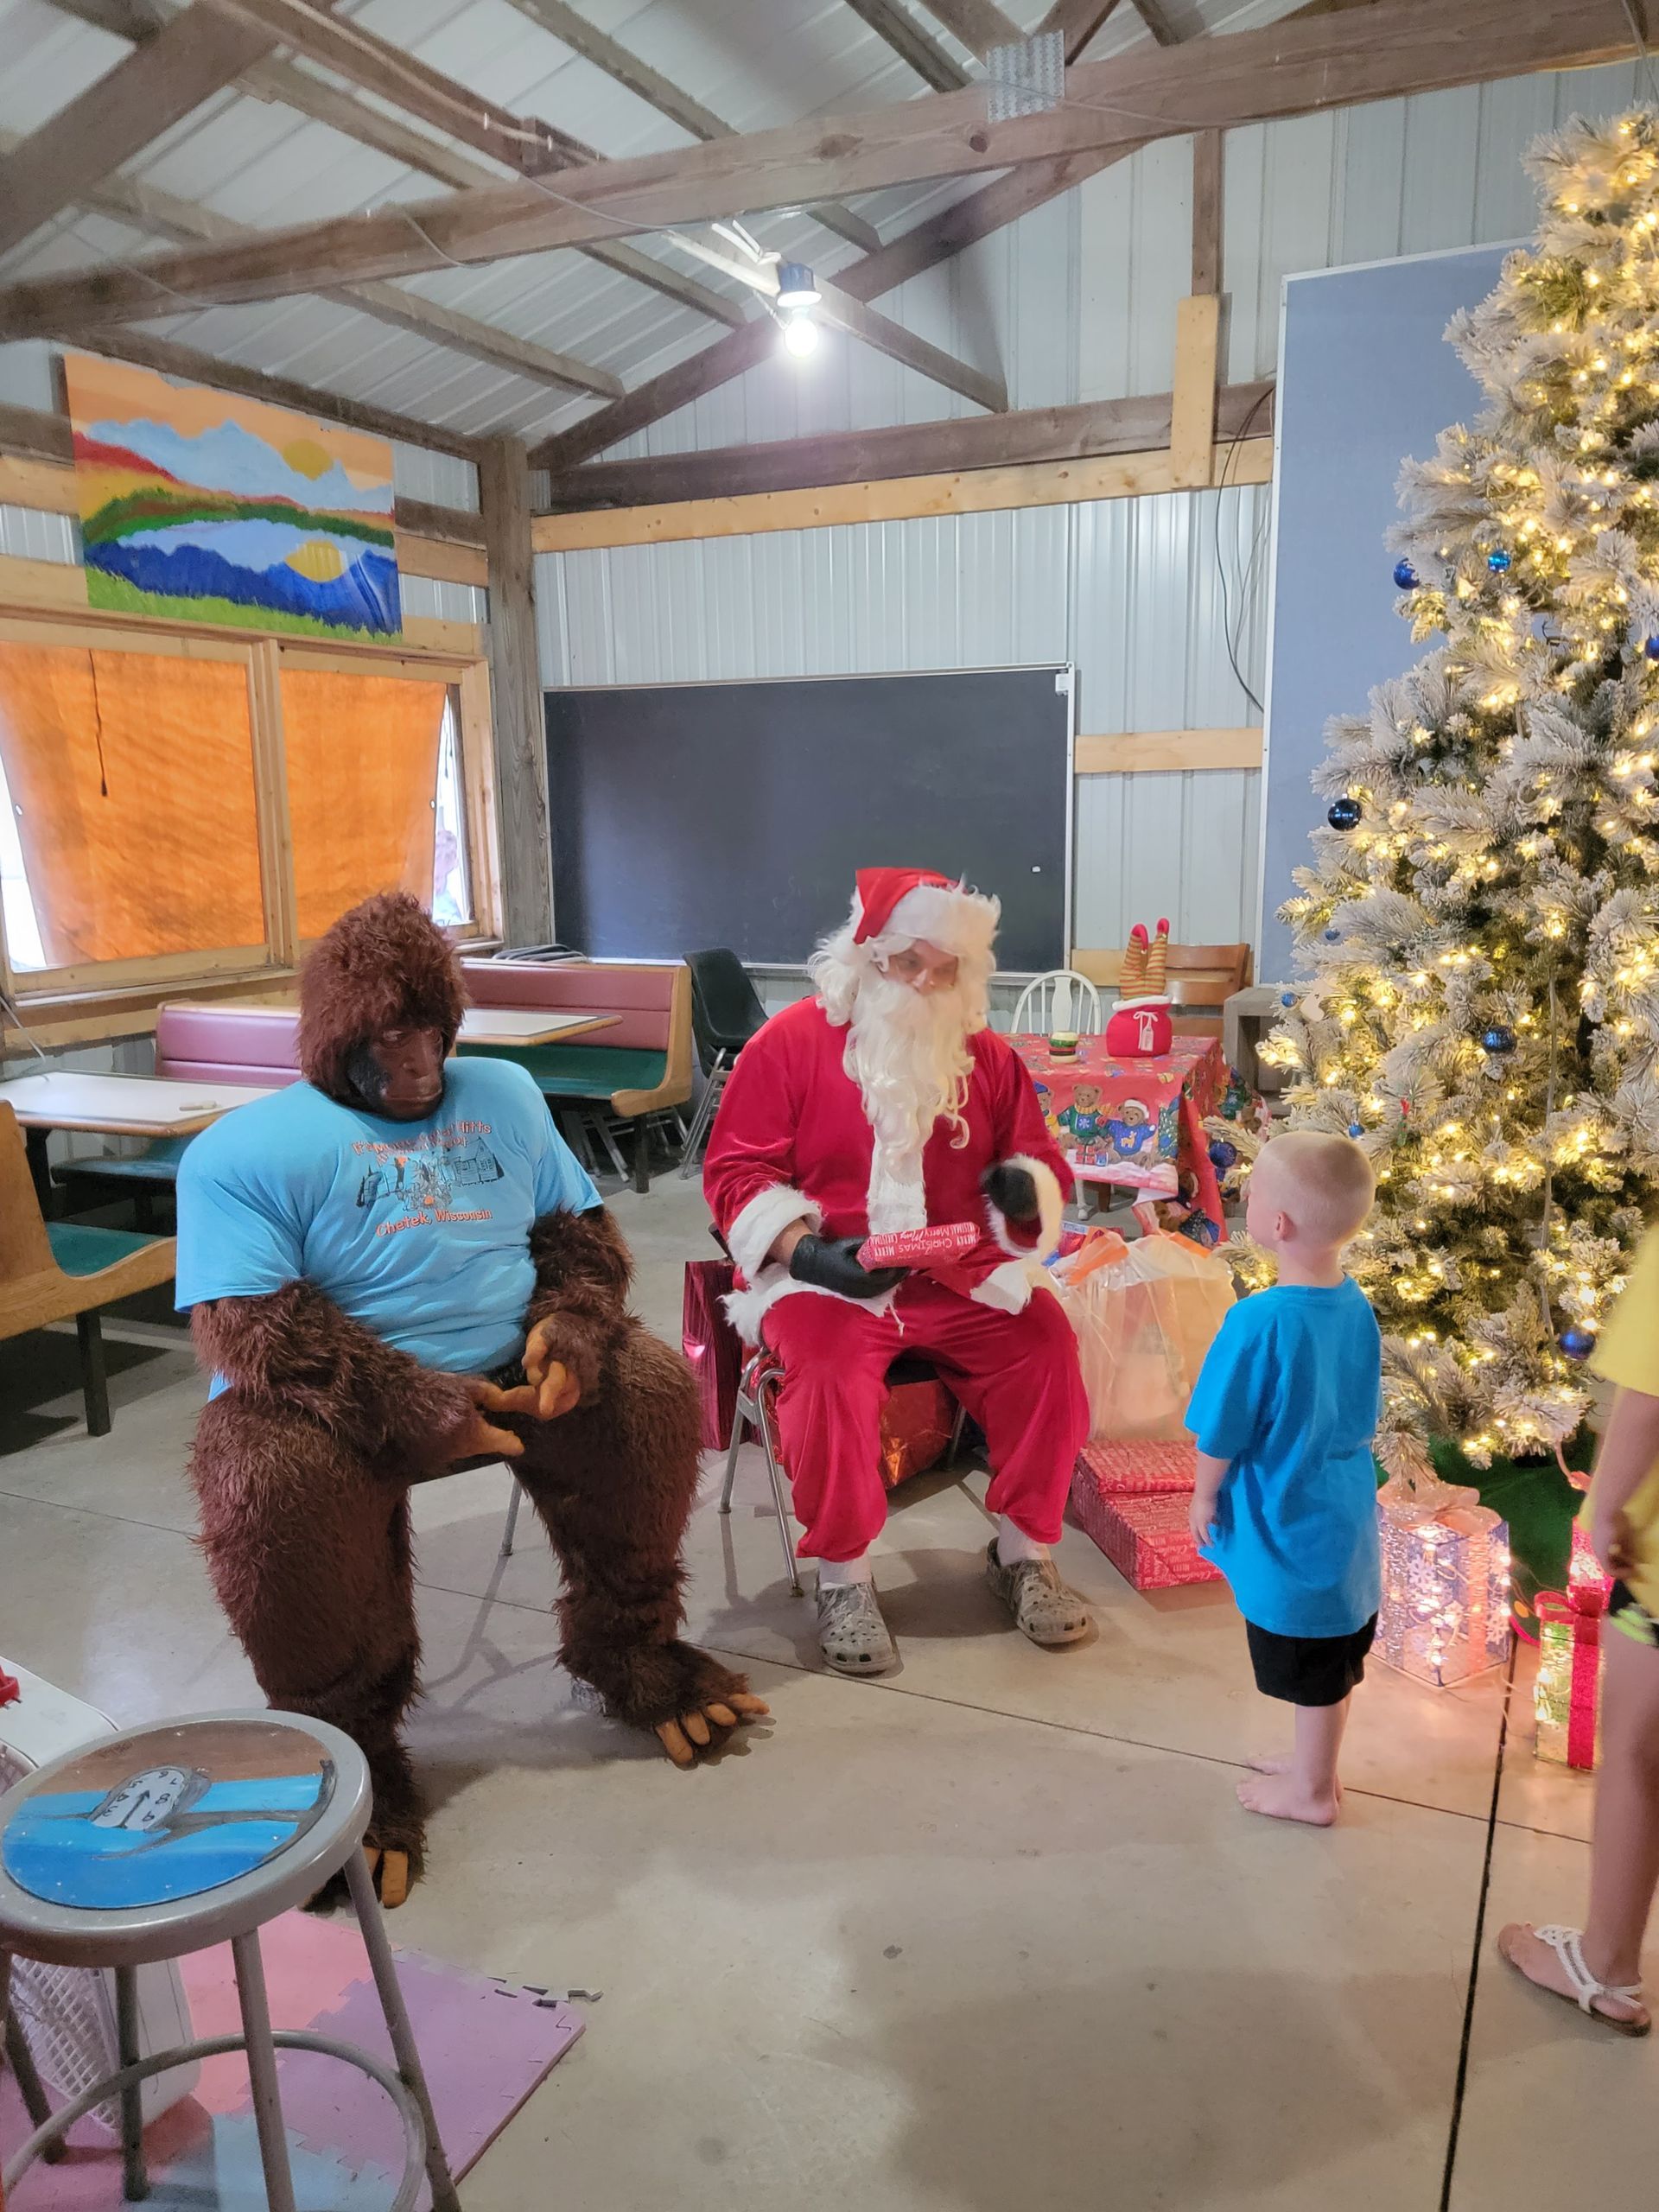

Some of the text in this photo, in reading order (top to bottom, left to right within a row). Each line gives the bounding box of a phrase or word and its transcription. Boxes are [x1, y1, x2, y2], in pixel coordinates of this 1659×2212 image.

[375, 1209, 493, 1236] Chetek, Wisconsin
[874, 1245, 895, 1256] MERRY
[899, 1237, 952, 1253] CHRISTMAS
[155, 1793, 171, 1805] 8
[102, 1806, 118, 1817] 3
